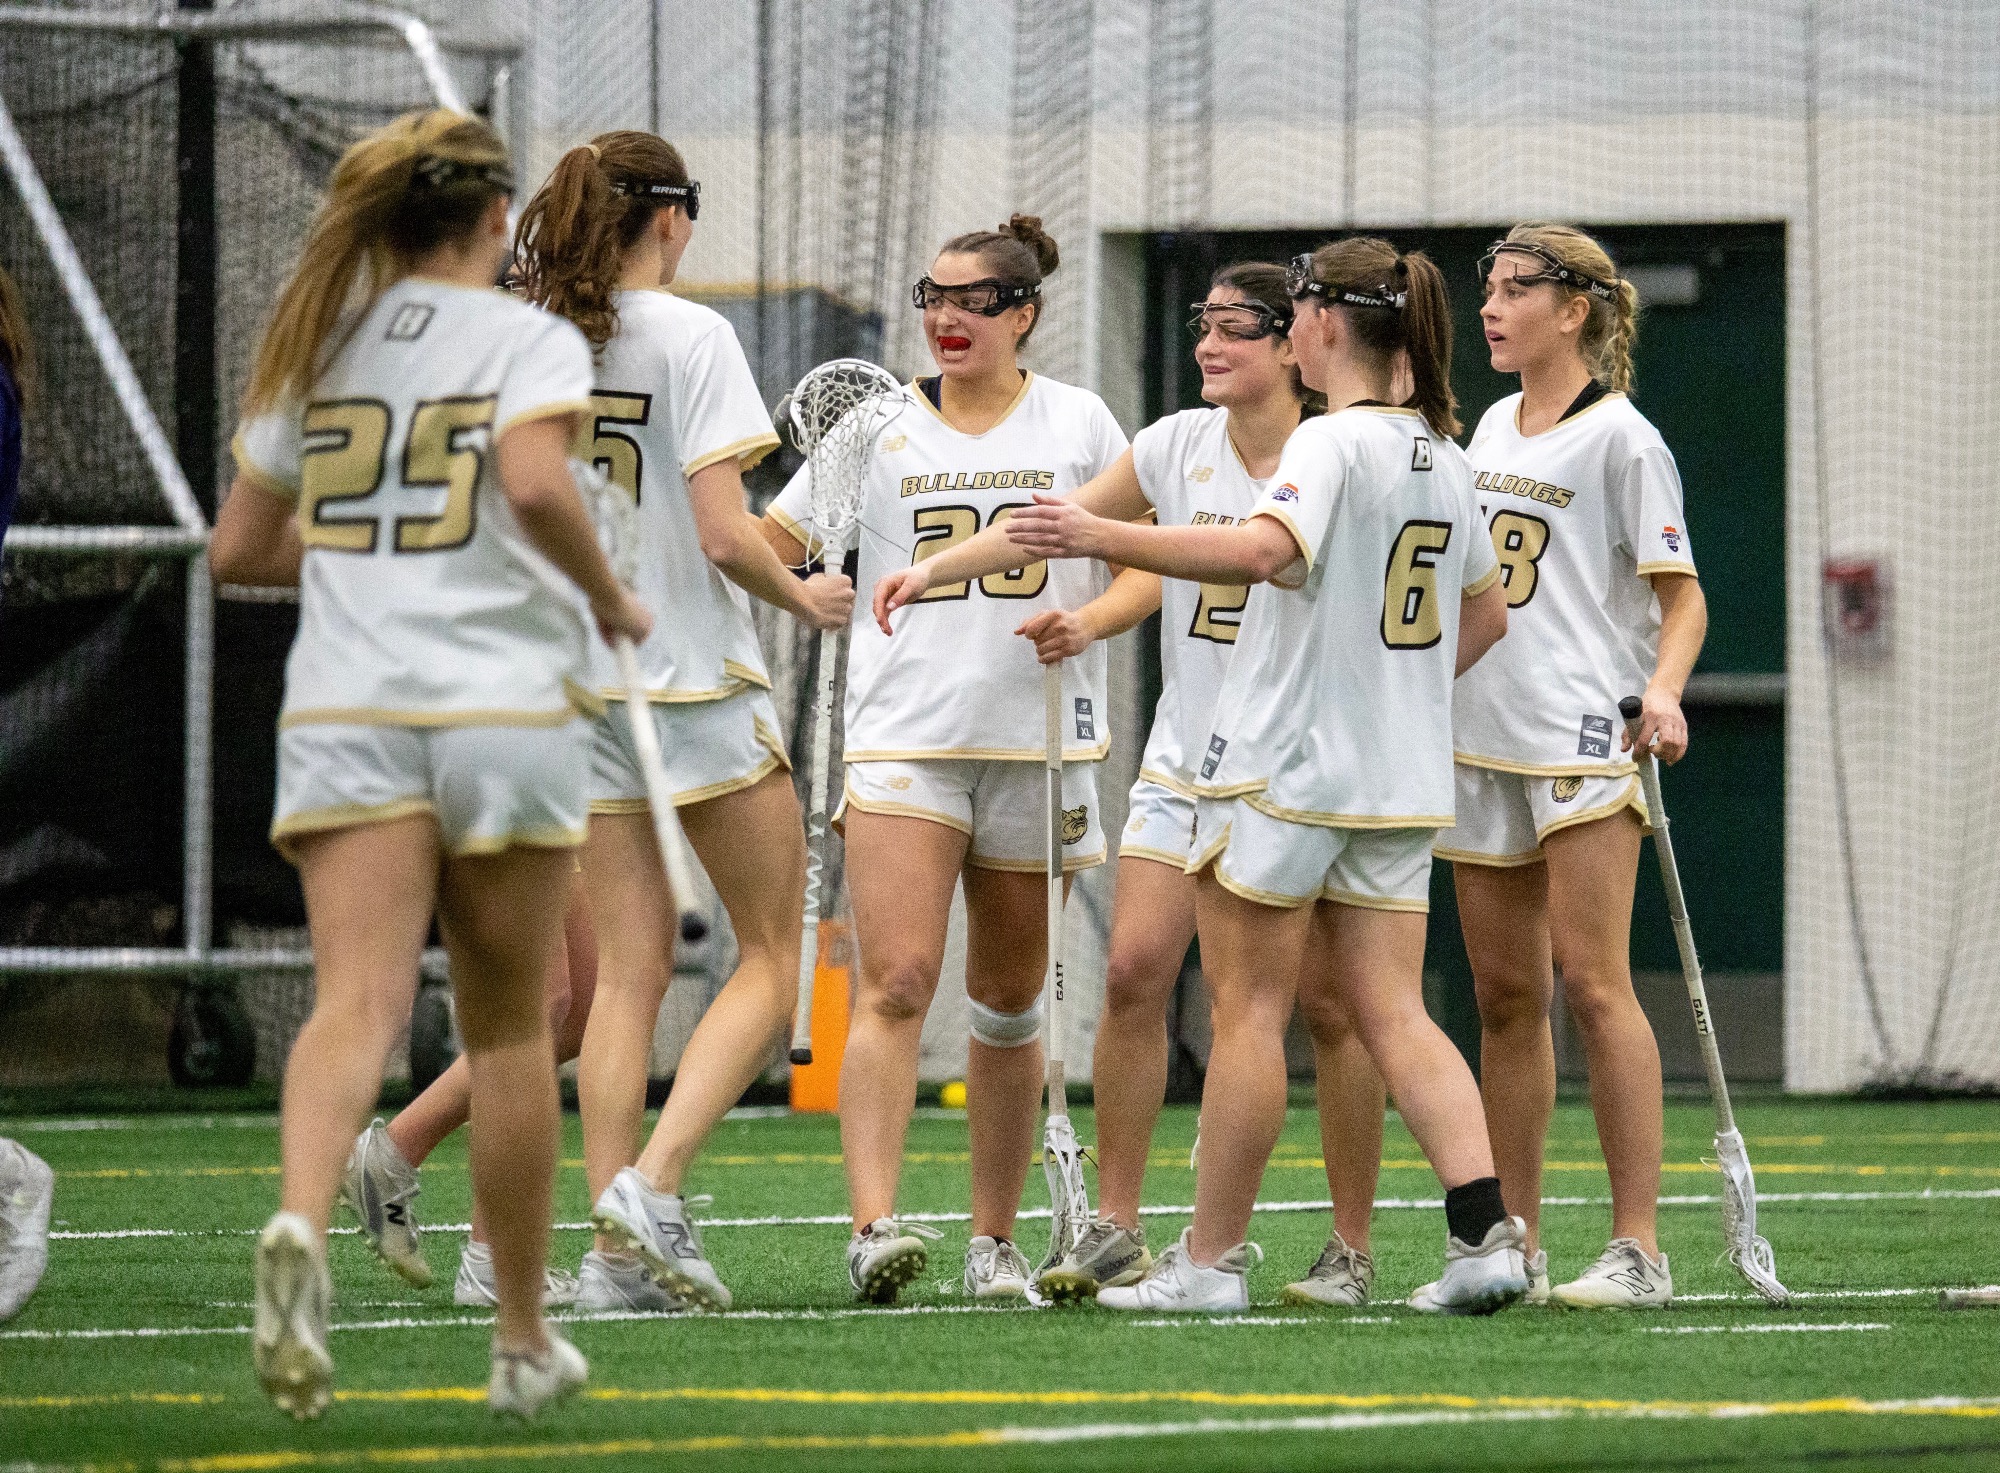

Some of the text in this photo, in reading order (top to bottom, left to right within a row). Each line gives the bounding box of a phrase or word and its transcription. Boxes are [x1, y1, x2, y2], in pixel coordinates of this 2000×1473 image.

[650, 185, 688, 196] BRINE
[301, 391, 498, 556] 25
[901, 470, 1055, 498] BULLDOGS
[1473, 470, 1575, 508] LLDOGS
[1480, 505, 1550, 609] 8
[1380, 519, 1453, 650] 6
[1080, 726, 1092, 738] XL
[1585, 742, 1602, 755] XL
[1692, 999, 1709, 1034] GAIT
